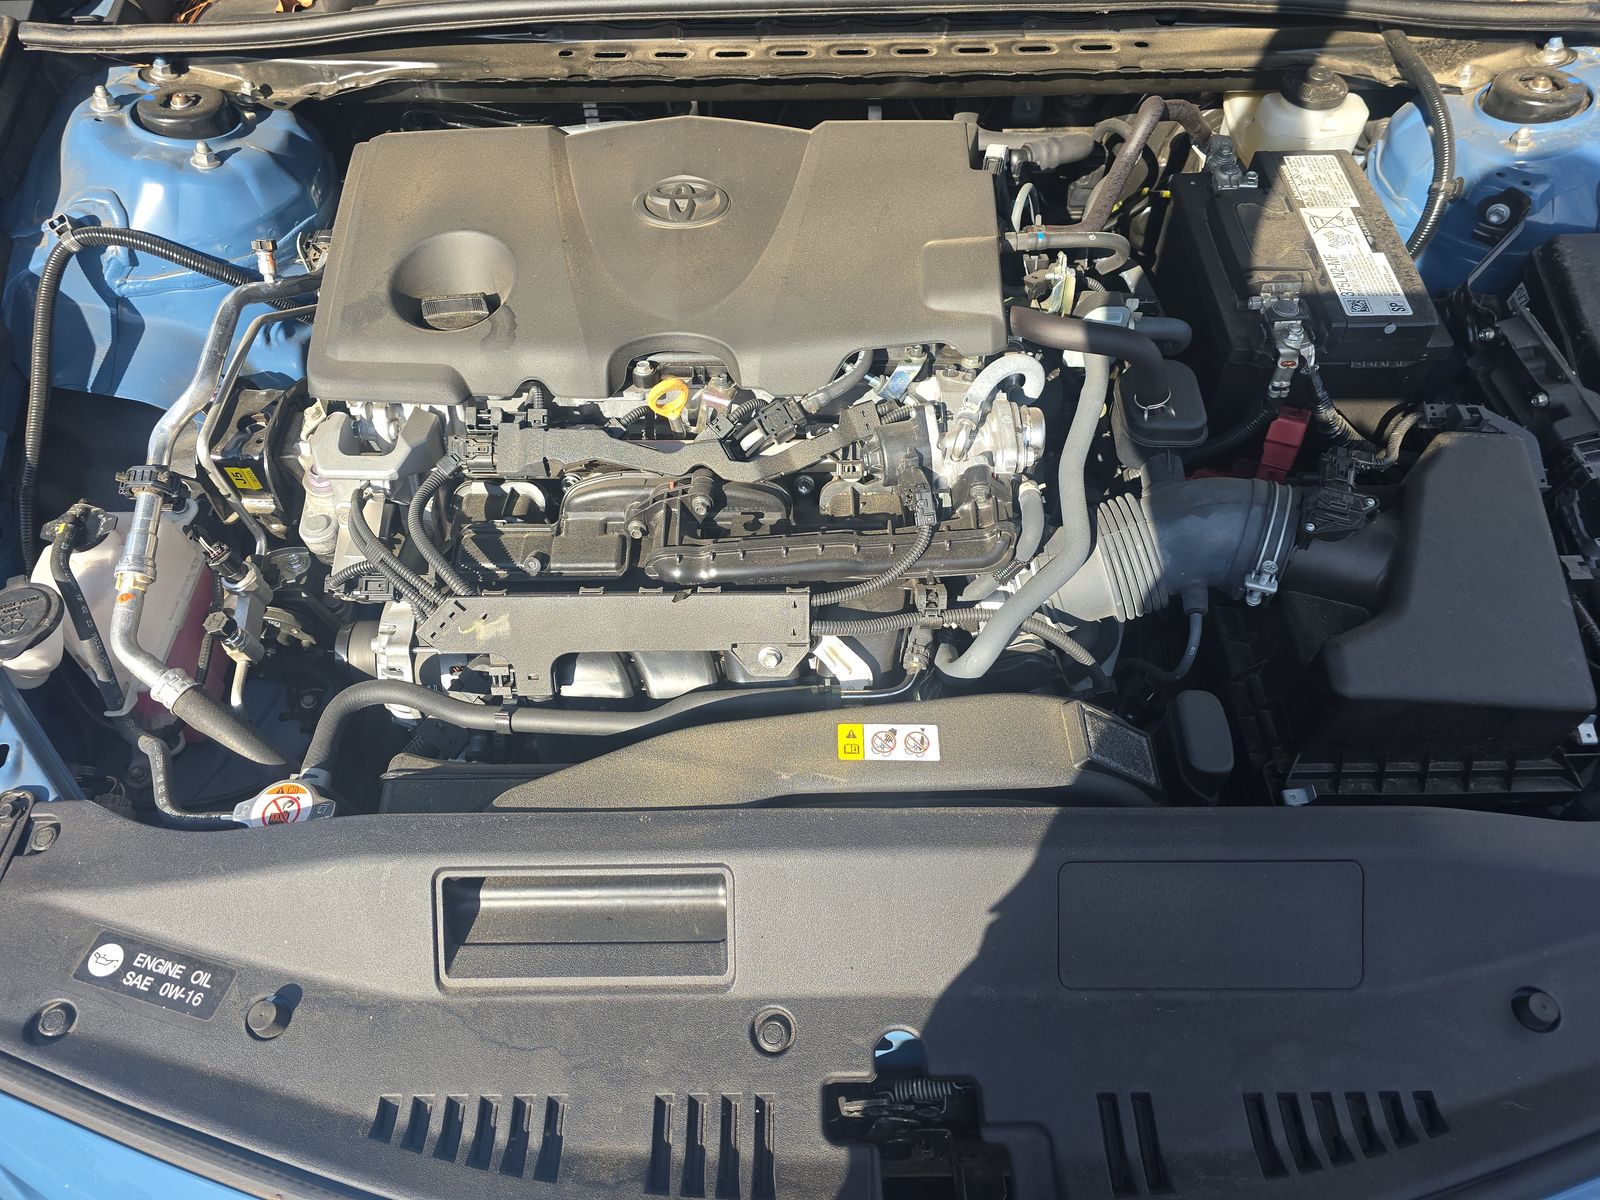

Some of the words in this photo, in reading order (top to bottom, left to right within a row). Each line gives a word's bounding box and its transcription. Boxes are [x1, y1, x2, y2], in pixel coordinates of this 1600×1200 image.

[1324, 254, 1354, 297] 375LN2-MF
[1391, 302, 1407, 312] SP
[133, 953, 186, 979] ENGINE
[190, 969, 212, 988] OIL
[122, 971, 155, 992] SAE
[158, 982, 205, 1007] 0W-16
